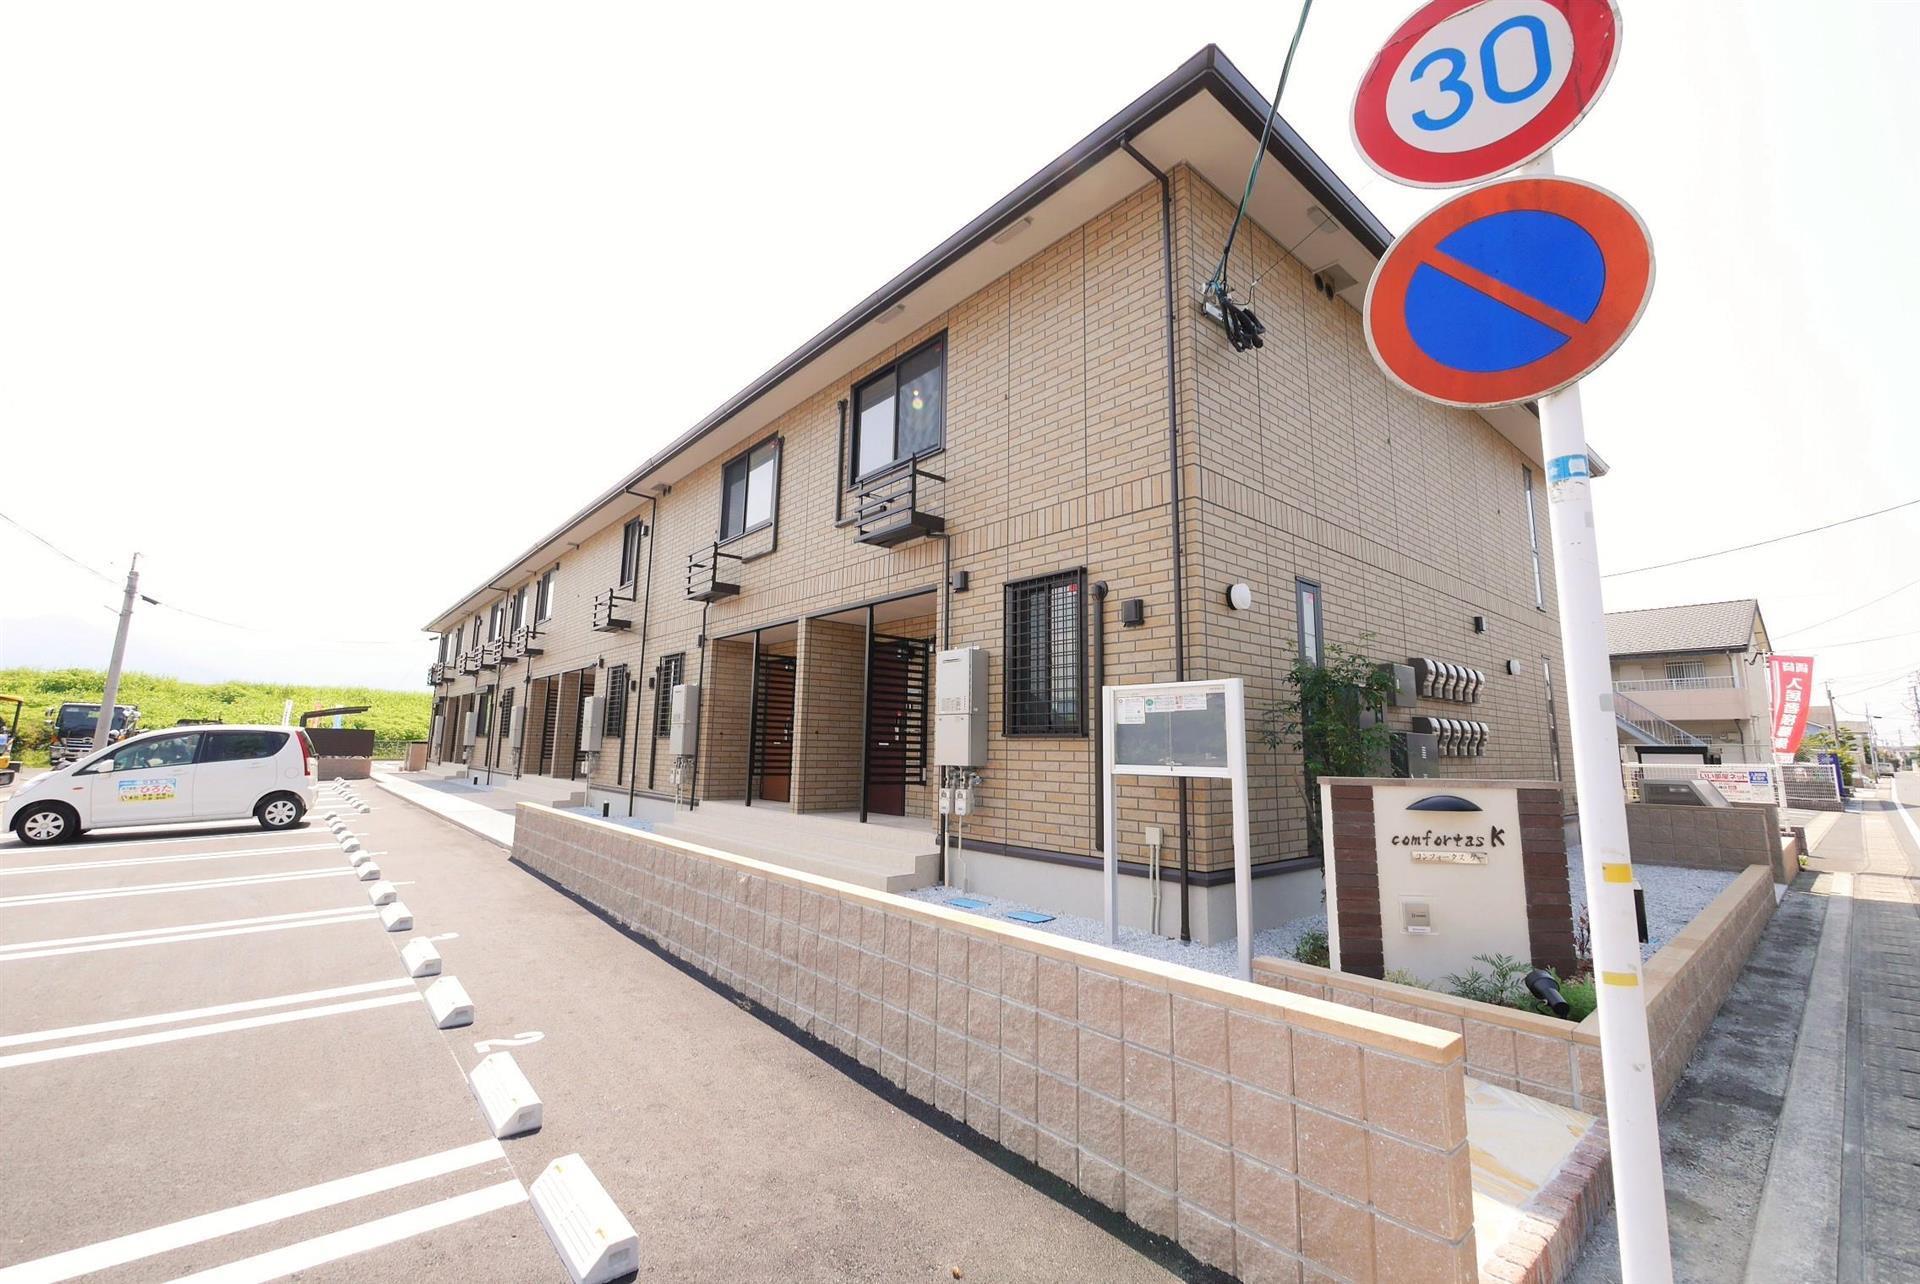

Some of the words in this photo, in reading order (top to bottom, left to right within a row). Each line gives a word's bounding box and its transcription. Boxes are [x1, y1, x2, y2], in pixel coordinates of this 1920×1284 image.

[1410, 15, 1552, 131] 30
[1391, 830, 1485, 847] comfortas
[1490, 825, 1505, 848] K
